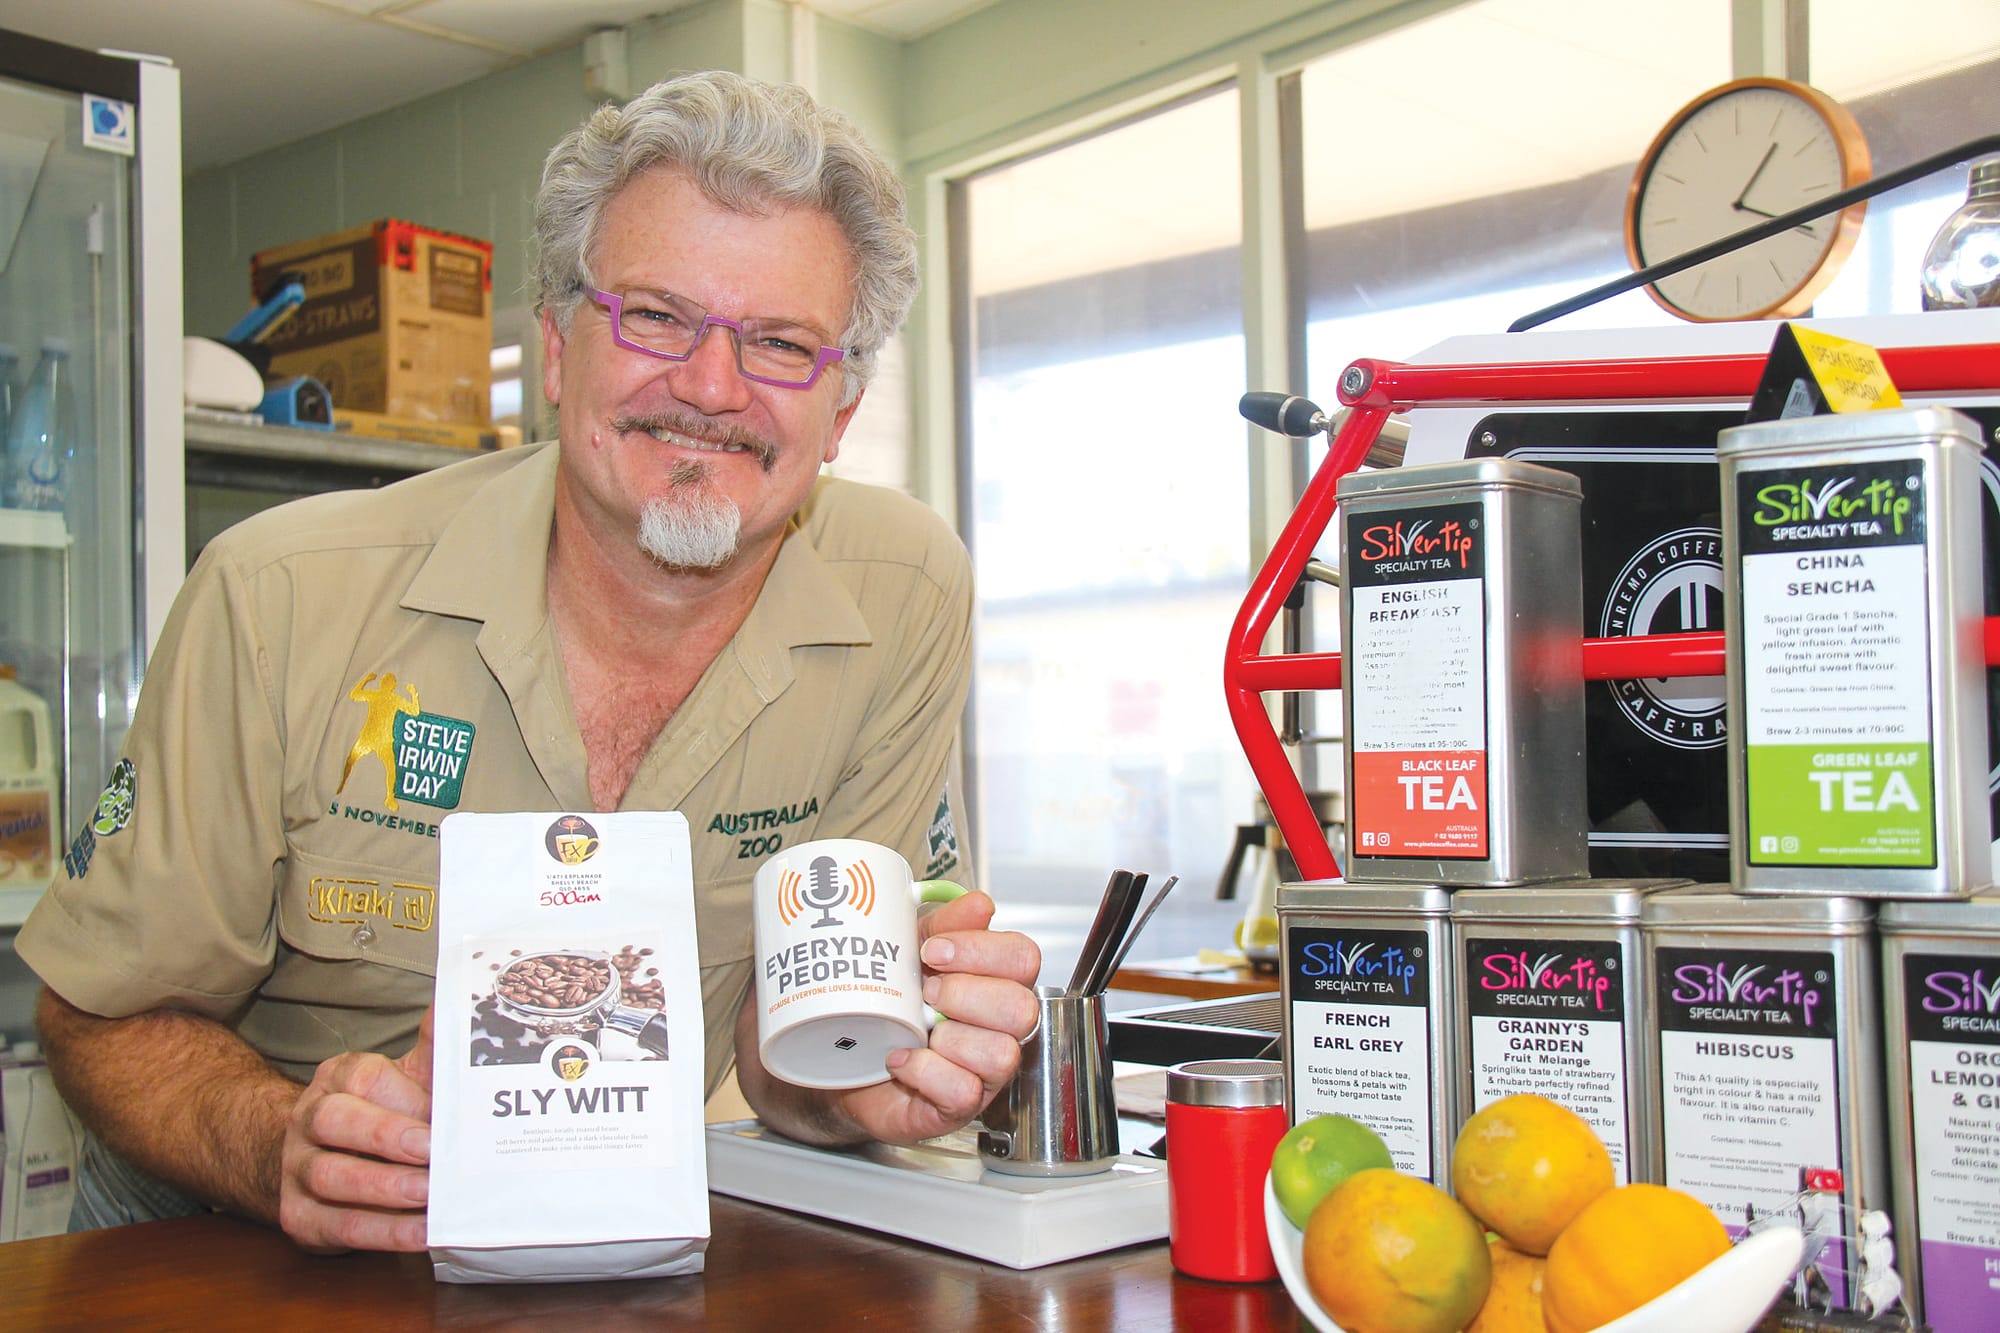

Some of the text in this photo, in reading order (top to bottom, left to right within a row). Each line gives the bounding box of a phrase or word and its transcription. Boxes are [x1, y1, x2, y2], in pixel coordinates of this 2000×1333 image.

[1772, 521, 1882, 541] SPECIALTY TEA
[1657, 540, 1723, 564] COFFE
[1374, 558, 1451, 574] SPECIALTY TEA
[1796, 554, 1864, 570] CHINA
[1787, 579, 1876, 597] SENCHA
[1370, 606, 1461, 623] BREAKAST
[1763, 611, 1848, 625] Special Grade 1
[1776, 624, 1884, 637] light green leaf with
[1761, 640, 1796, 650] yellow
[1850, 636, 1901, 646] Aromatic
[1785, 652, 1812, 661] fresh
[1854, 649, 1877, 658] with
[1765, 665, 1816, 675] delightful
[1819, 664, 1852, 672] sweet
[403, 719, 470, 753] STEVE
[1766, 726, 1791, 735] Brew
[1794, 726, 1810, 735] 2-3
[1812, 726, 1853, 734] minutes
[1856, 726, 1866, 734] at
[399, 744, 462, 779] IRWIN
[1402, 759, 1477, 771] BLACK LEAF
[1812, 752, 1918, 767] GREEN LEAF
[402, 772, 446, 799] DAY
[1397, 775, 1478, 811] TEA
[1808, 771, 1920, 812] TEA
[344, 805, 440, 839] NOVEMBE
[706, 796, 819, 836] AUSTRALIA
[737, 833, 783, 859] ZOO
[317, 885, 394, 920] Khaki
[766, 936, 900, 980] EVERYDAY
[779, 959, 887, 994] PEOPLE
[1315, 979, 1394, 994] SPECIALTY TEA
[769, 997, 791, 1015] BECAUSE
[792, 986, 827, 1002] EVERYONE
[828, 983, 852, 994] LOVES
[860, 985, 882, 993] GREAT
[883, 987, 903, 999] STORY
[1496, 994, 1584, 1007] SPECIALTY TEA
[1325, 1013, 1390, 1028] FRENCH
[1689, 1007, 1791, 1024] SPECIALTY TEA
[1498, 1020, 1590, 1036] GRANNY'S
[1314, 1036, 1404, 1053] EARL GREY
[1509, 1037, 1584, 1053] GARDEN
[1695, 1041, 1794, 1060] HIBISCUS
[1504, 1052, 1591, 1068] Fruit Melange
[1308, 1065, 1333, 1074] Exotic
[1335, 1067, 1358, 1076] blend
[1360, 1069, 1369, 1077] of
[1370, 1069, 1393, 1078] black
[1482, 1064, 1616, 1081] Springlike taste of strawberry
[1312, 1077, 1351, 1087] blossoms
[1361, 1081, 1387, 1089] petals
[1389, 1082, 1407, 1090] with
[1497, 1076, 1532, 1087] rhubarb
[1534, 1079, 1574, 1090] perfectly
[1577, 1082, 1610, 1091] refined
[1674, 1072, 1819, 1091] This A1 quality is especially
[1317, 1088, 1402, 1101] fruity bergamot taste
[1483, 1088, 1502, 1096] with
[1673, 1085, 1703, 1096] bright
[1706, 1087, 1715, 1096] in
[1718, 1088, 1751, 1098] colour
[1755, 1090, 1762, 1098] &
[1765, 1091, 1784, 1100] has
[1797, 1093, 1821, 1103] mild
[1952, 1092, 1967, 1106] &
[492, 1086, 649, 1118] SLY WITT
[1575, 1106, 1599, 1114] taste
[1720, 1100, 1727, 1109] It
[1730, 1102, 1739, 1110] is
[1742, 1103, 1765, 1112] also
[1768, 1105, 1815, 1117] naturally
[1602, 1118, 1616, 1127] for
[1702, 1112, 1722, 1122] rich
[1725, 1113, 1735, 1122] in
[1738, 1115, 1777, 1125] vitamin
[1949, 1116, 1991, 1129] Natural
[1954, 1144, 1990, 1156] sweet
[1952, 1157, 1998, 1169] delicate
